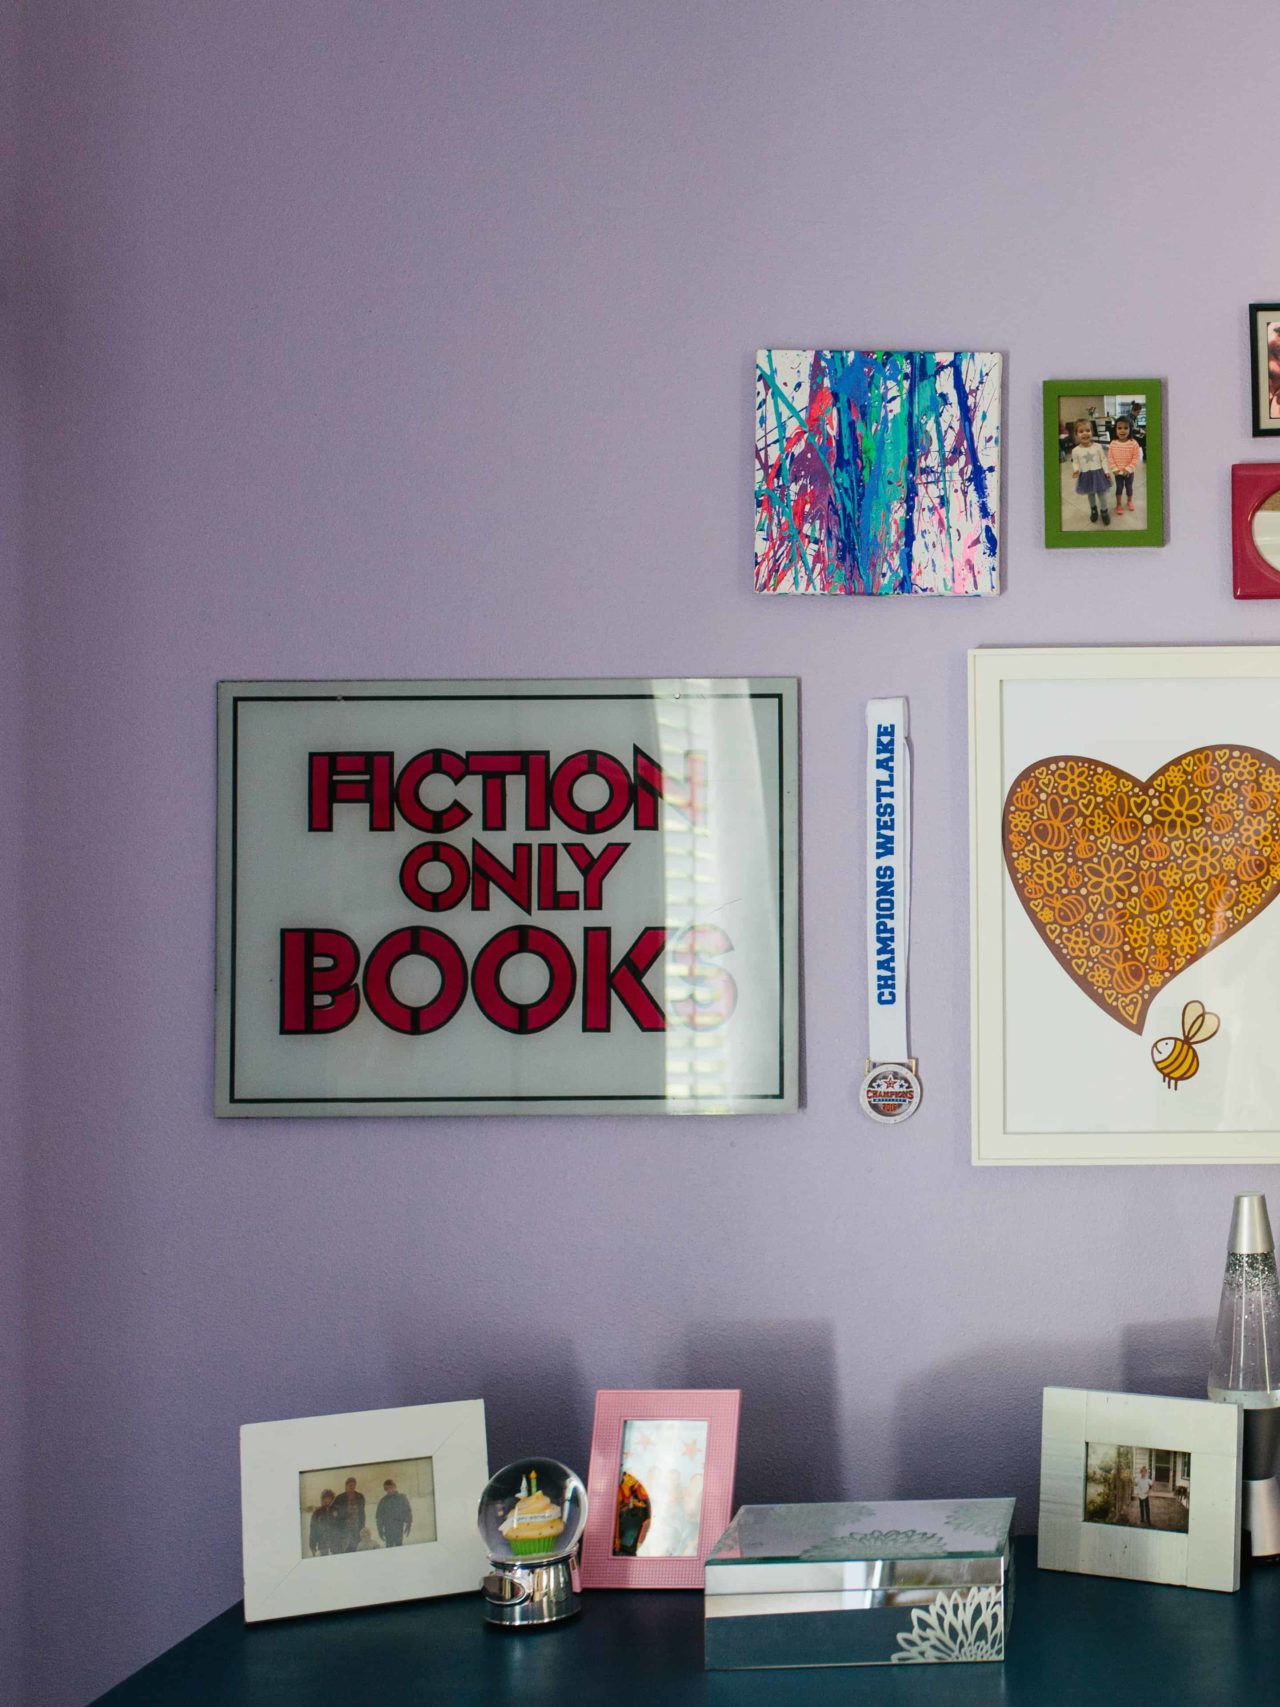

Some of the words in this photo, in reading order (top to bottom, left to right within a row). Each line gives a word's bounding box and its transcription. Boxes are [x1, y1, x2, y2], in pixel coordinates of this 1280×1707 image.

[307, 743, 709, 838] FICTION
[876, 723, 895, 860] WESTLAKE
[400, 837, 631, 916] ONLY
[279, 923, 738, 1036] BOOKS
[876, 865, 897, 1006] CHAMPIONS
[866, 1089, 914, 1100] CHAMPIONS
